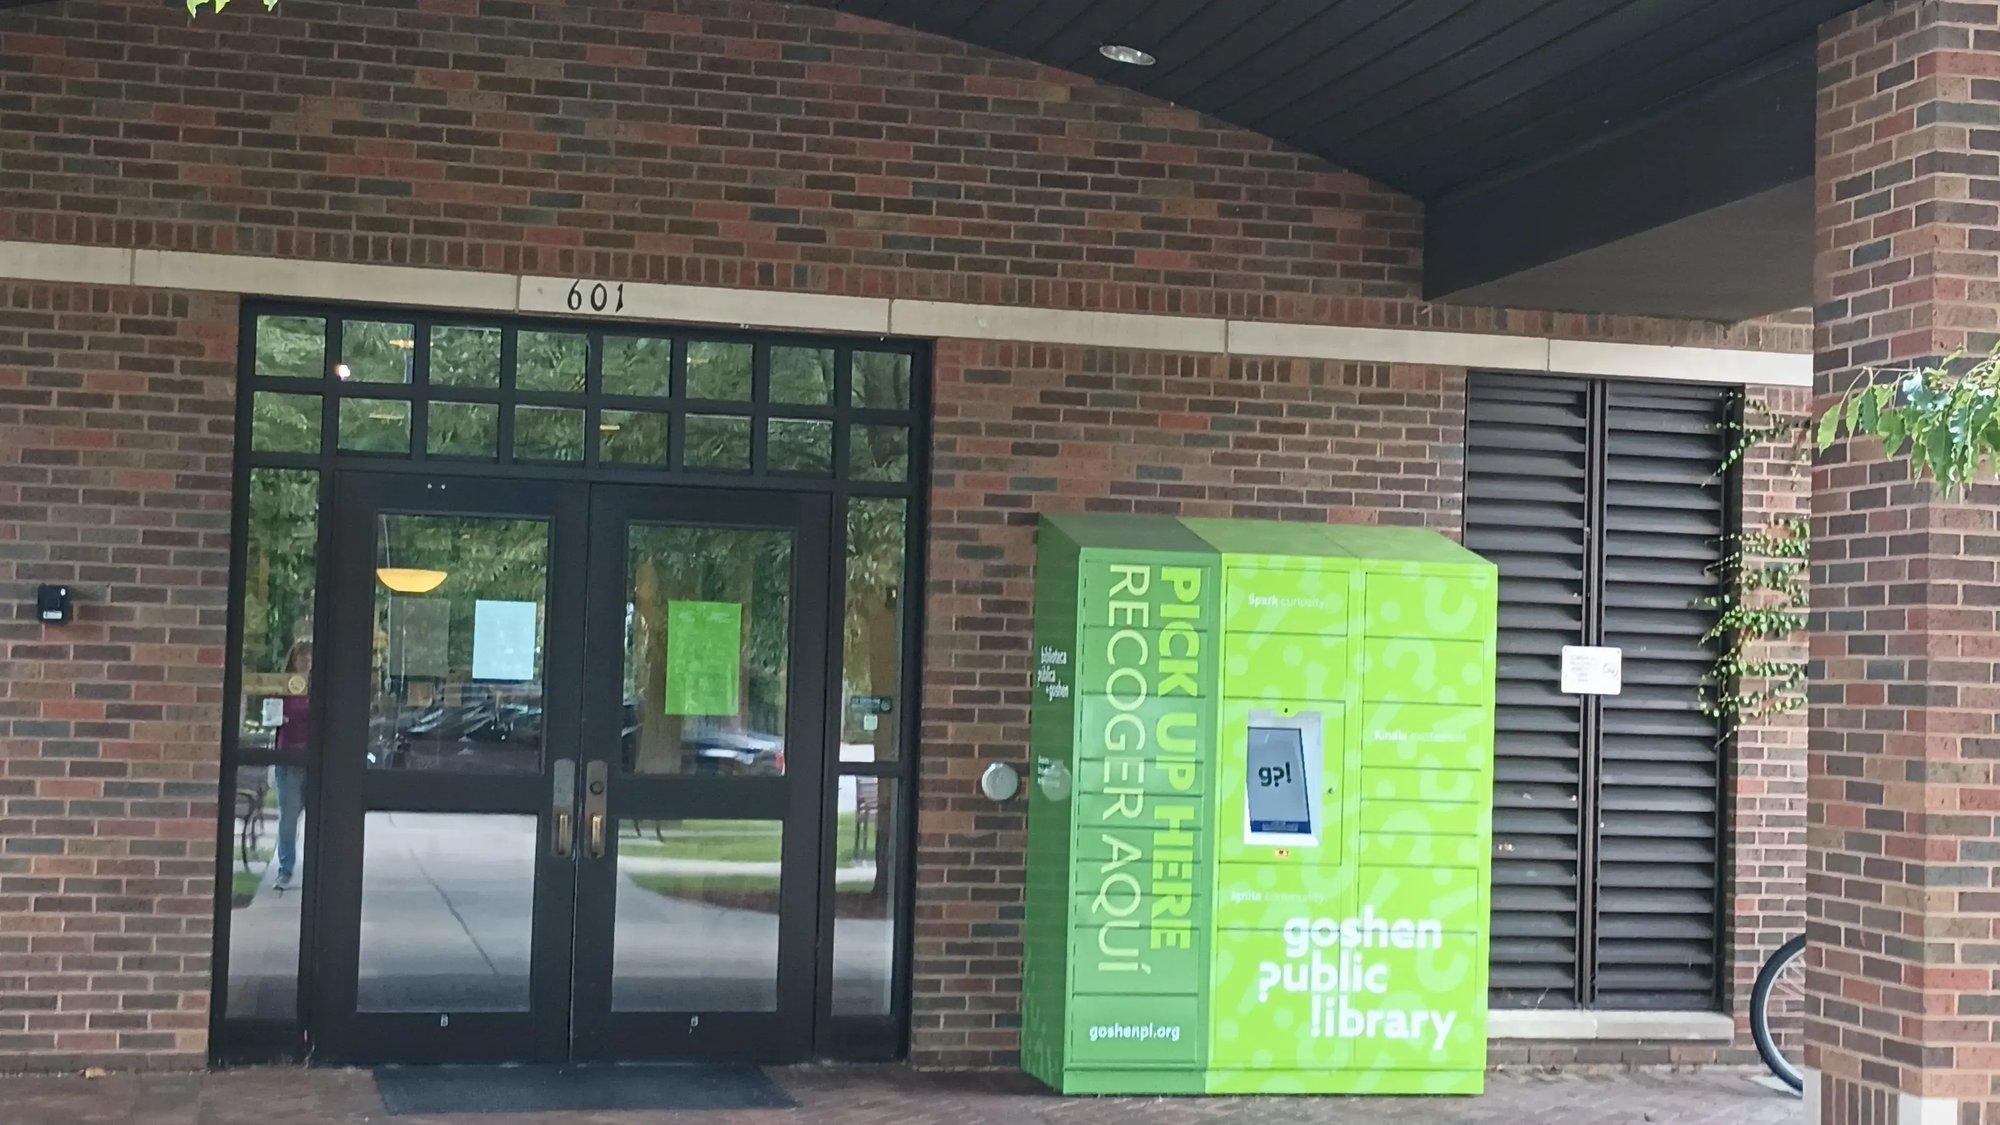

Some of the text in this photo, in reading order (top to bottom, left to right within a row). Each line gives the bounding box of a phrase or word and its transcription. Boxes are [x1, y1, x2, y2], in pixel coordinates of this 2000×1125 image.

[567, 279, 624, 313] 601
[1247, 592, 1279, 608] Spark
[1092, 564, 1151, 975] RECOGER AQUÍ
[1150, 566, 1201, 949] PICK UP HERE
[1283, 904, 1443, 958] goshen
[1089, 1022, 1180, 1041] goshenpl.org
